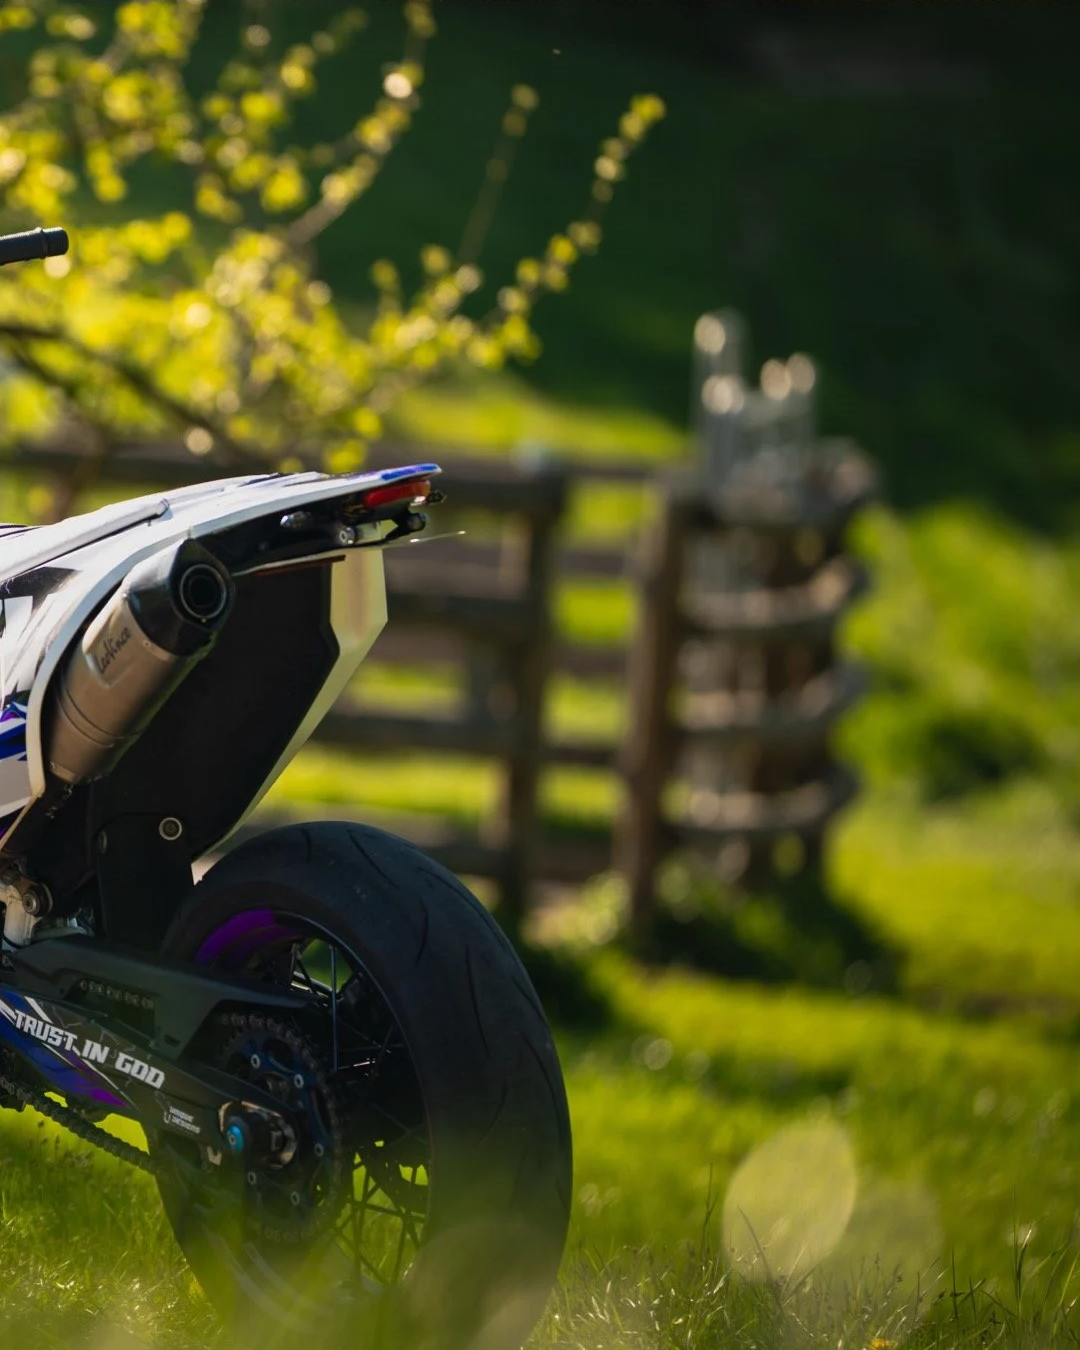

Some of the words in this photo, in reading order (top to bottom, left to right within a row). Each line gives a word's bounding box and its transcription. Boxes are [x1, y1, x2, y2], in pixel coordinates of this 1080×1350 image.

[15, 1009, 78, 1050] TRUST
[81, 1039, 110, 1064] IN
[114, 1051, 165, 1089] GOD
